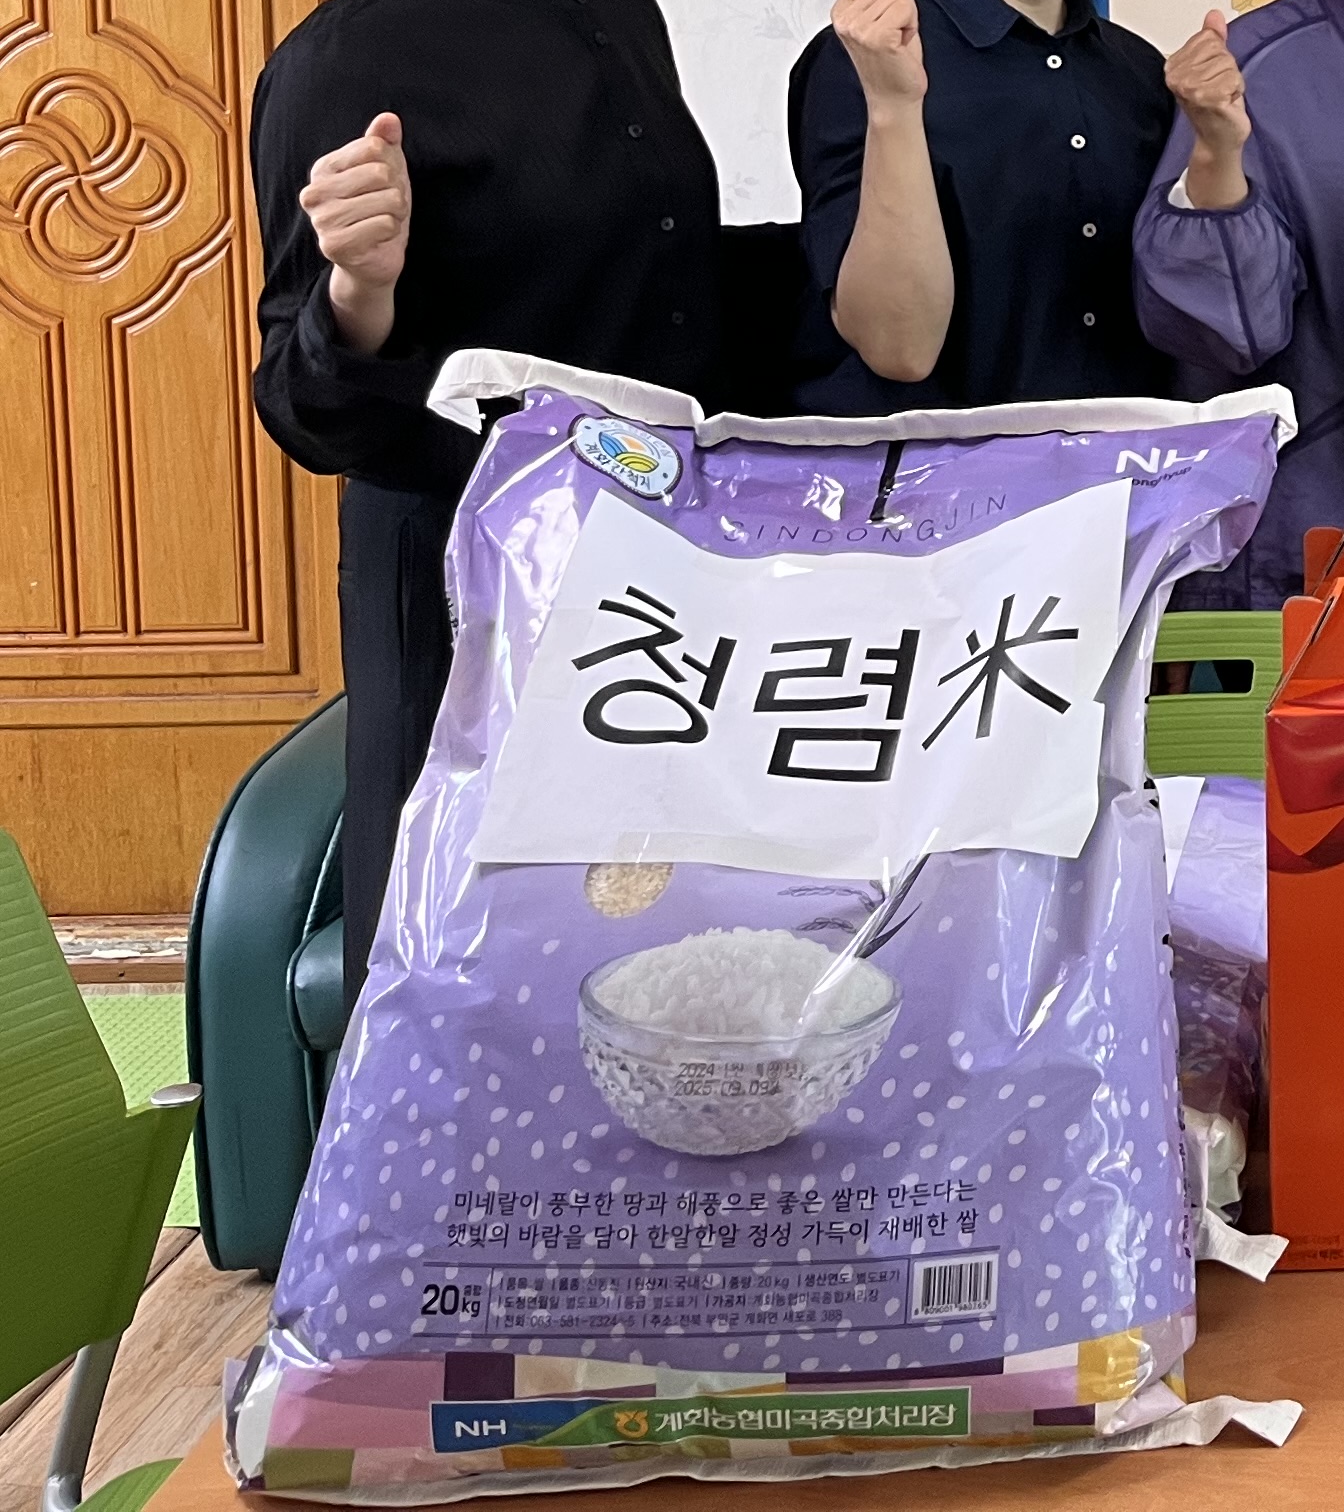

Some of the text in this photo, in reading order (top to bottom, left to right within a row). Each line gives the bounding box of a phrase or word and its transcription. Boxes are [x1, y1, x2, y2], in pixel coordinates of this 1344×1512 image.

[1115, 445, 1211, 474] NH
[721, 493, 1008, 544] SINDONGJIN
[572, 586, 1080, 782] 청렴米
[453, 1179, 978, 1217] 미네랄이 풍부한 땅과 해풍으로 좋은 쌀만 만든다는
[446, 1209, 979, 1251] 햇빛의 바람을 담아 한알한알 정성 가득이 재배한 쌀
[421, 1283, 460, 1316] 20
[461, 1297, 481, 1318] kg
[455, 1404, 957, 1437] NH 계화농협미곡종합처리장
